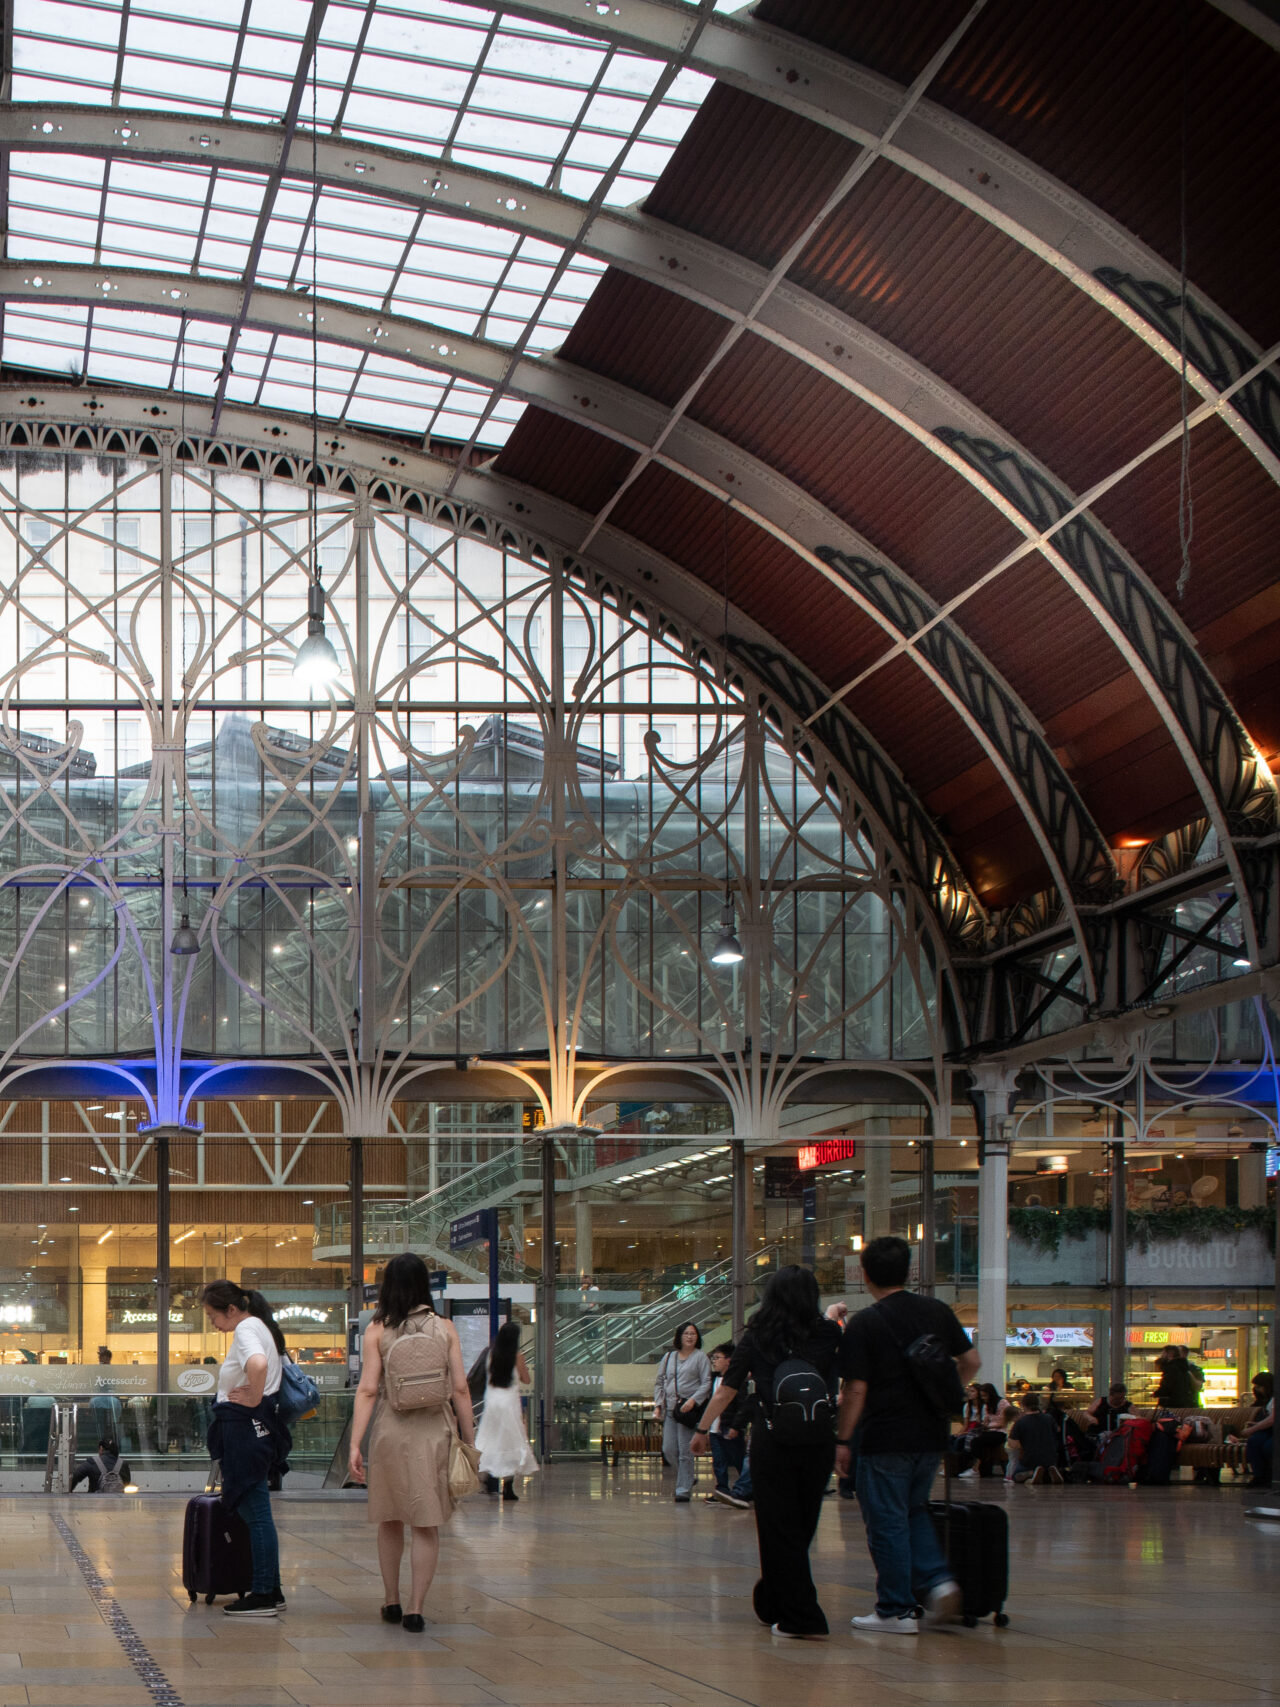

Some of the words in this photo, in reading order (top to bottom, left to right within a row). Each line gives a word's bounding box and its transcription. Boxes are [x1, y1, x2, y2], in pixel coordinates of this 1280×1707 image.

[122, 1309, 184, 1324] Accessize
[272, 1305, 328, 1323] FATFACE
[1144, 1332, 1169, 1343] FRESH
[94, 1376, 148, 1387] Accessorize
[567, 1375, 606, 1385] COSTA
